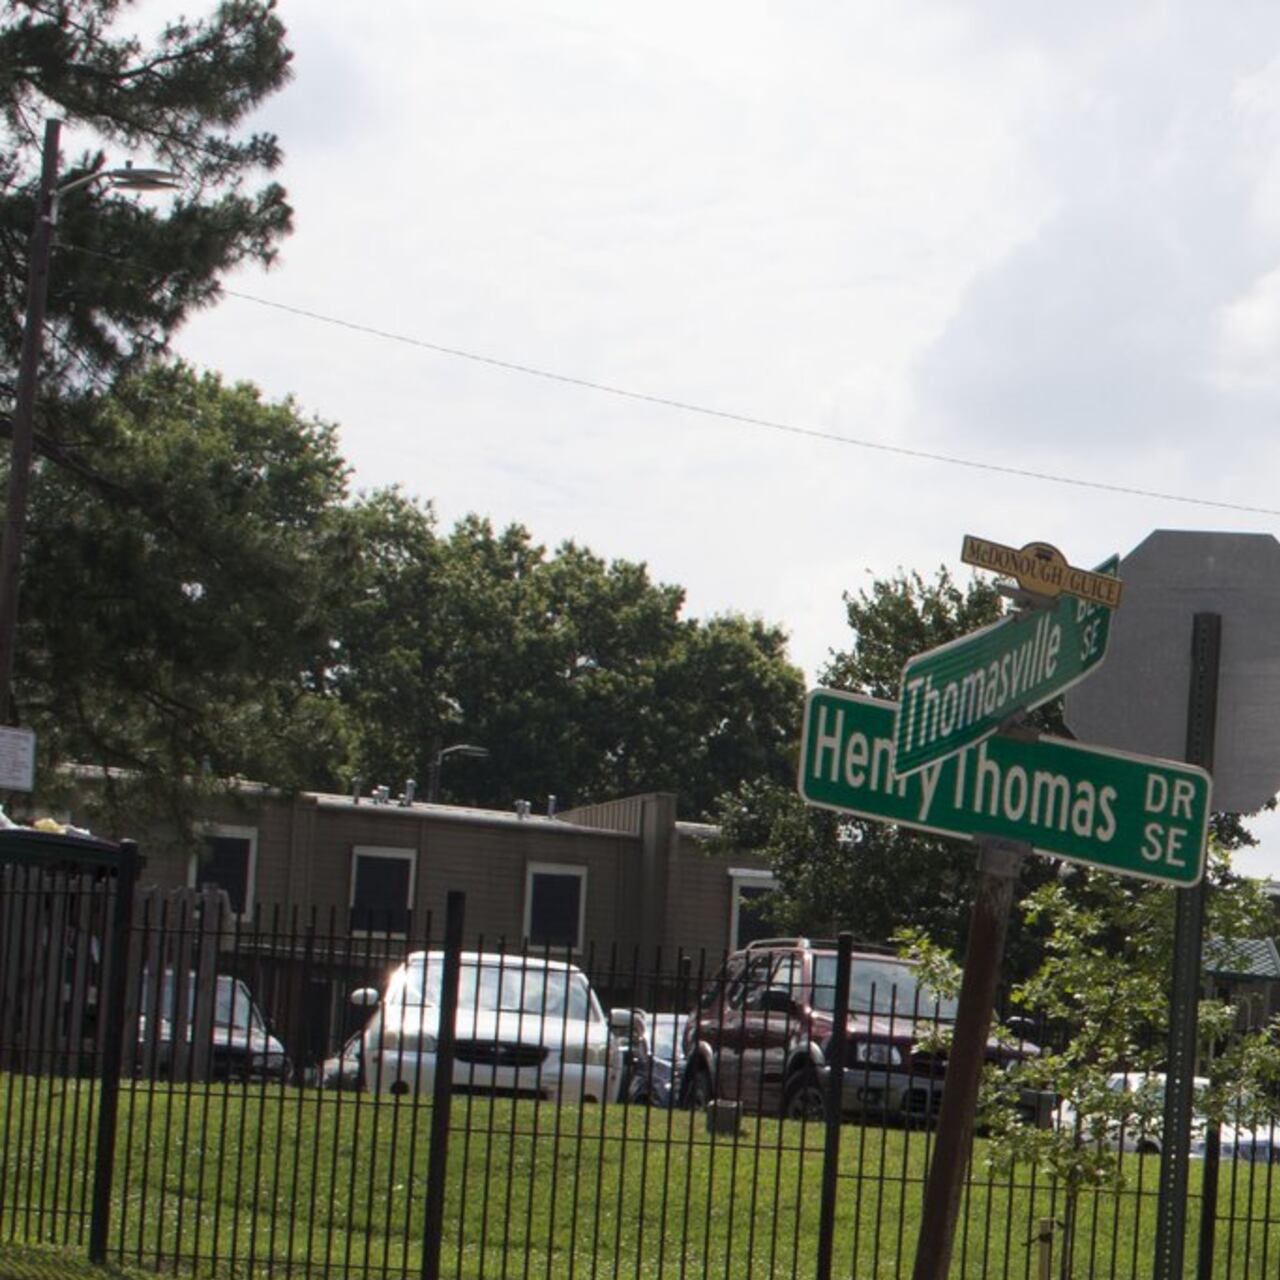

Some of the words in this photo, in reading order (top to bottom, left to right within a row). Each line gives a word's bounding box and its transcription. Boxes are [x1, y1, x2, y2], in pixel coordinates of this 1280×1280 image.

[1080, 619, 1100, 661] SE
[907, 612, 1061, 752] Thomasville
[954, 741, 1117, 842] Thomas
[1144, 772, 1196, 820] DR
[1140, 822, 1187, 867] SE
